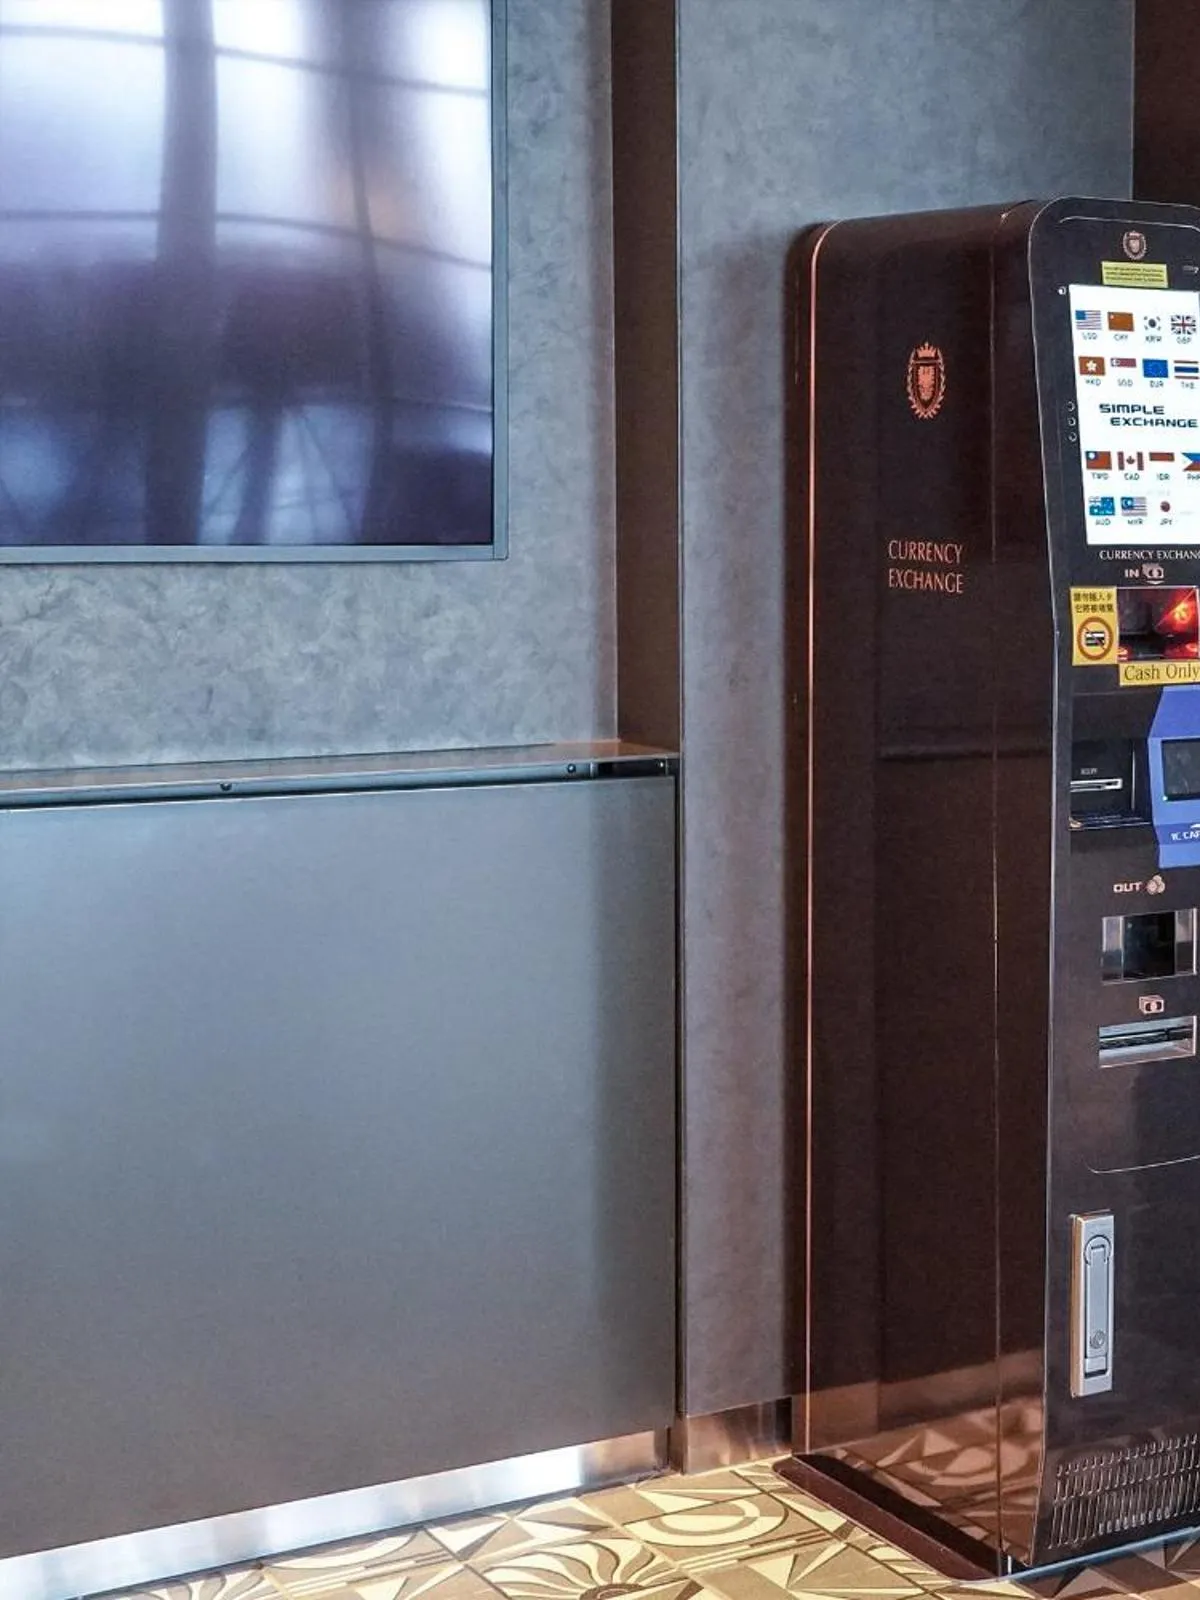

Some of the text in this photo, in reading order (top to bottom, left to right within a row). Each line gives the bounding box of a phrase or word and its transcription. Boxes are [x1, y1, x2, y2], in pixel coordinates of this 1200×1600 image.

[1098, 403, 1165, 415] SIMPLE
[1110, 417, 1199, 428] EXCHANGE
[888, 540, 963, 564] CURRENCY
[1099, 550, 1154, 560] CURRENCY
[1124, 568, 1140, 578] IN
[888, 567, 964, 594] EXCHANGE
[1124, 663, 1200, 680] Cash Only
[1113, 882, 1142, 893] OUT
